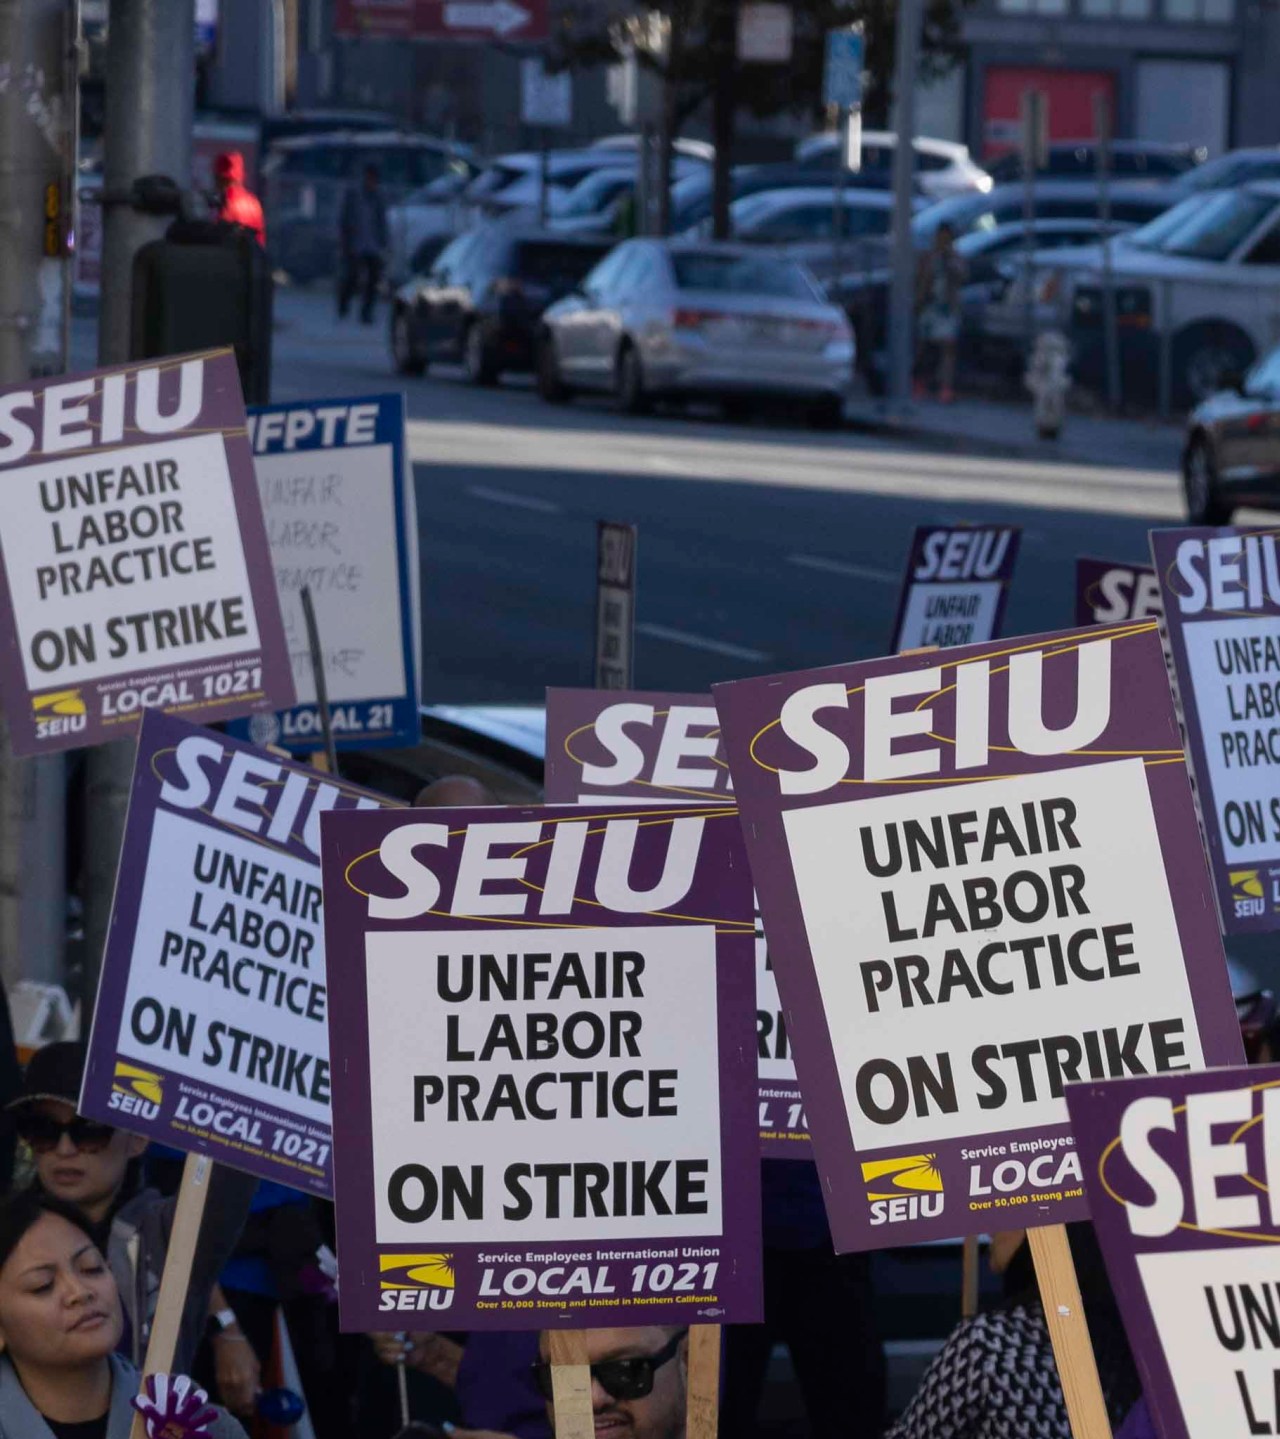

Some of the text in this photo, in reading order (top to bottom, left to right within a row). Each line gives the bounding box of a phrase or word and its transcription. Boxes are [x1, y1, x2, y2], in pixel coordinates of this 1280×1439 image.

[0, 359, 202, 462] SEIU
[38, 458, 180, 512] UNFAIR
[51, 500, 184, 554] LABOR
[35, 536, 215, 599] PRACTICE
[914, 530, 1012, 581] SEIU
[30, 623, 96, 671] ON
[106, 595, 246, 658] STRIKE
[921, 621, 975, 646] LABOR
[925, 593, 982, 620] UNFAIR
[102, 682, 193, 715] LOCAL
[203, 667, 259, 696] 1021
[368, 703, 393, 729] 21
[775, 639, 1109, 794] SEIU
[36, 714, 85, 736] SEIU
[582, 703, 734, 790] SE
[859, 798, 1080, 876] UNFAIR
[1224, 800, 1265, 846] ON
[194, 843, 322, 924] UNFAIR
[368, 817, 704, 918] SEIU
[189, 890, 313, 968] LABOR
[881, 864, 1089, 942] LABOR
[1236, 898, 1264, 915] SEIU
[159, 928, 328, 1021] PRACTICE
[437, 951, 644, 1002] UNFAIR
[859, 922, 1139, 1012] PRACTICE
[129, 995, 331, 1104] ON STRIKE
[447, 1011, 641, 1061] LABOR
[414, 1069, 677, 1121] PRACTICE
[854, 1052, 958, 1124] ON
[972, 1018, 1191, 1109] STRIKE
[107, 1090, 159, 1118] SEIU
[175, 1097, 328, 1164] LOCAL 1021
[388, 1159, 707, 1222] ON STRIKE
[970, 1148, 1084, 1195] LOCA
[870, 1193, 943, 1224] SEIU
[478, 1247, 718, 1263] Service Employees International Union
[479, 1263, 718, 1295] LOCAL 1021
[378, 1289, 453, 1310] SEIU
